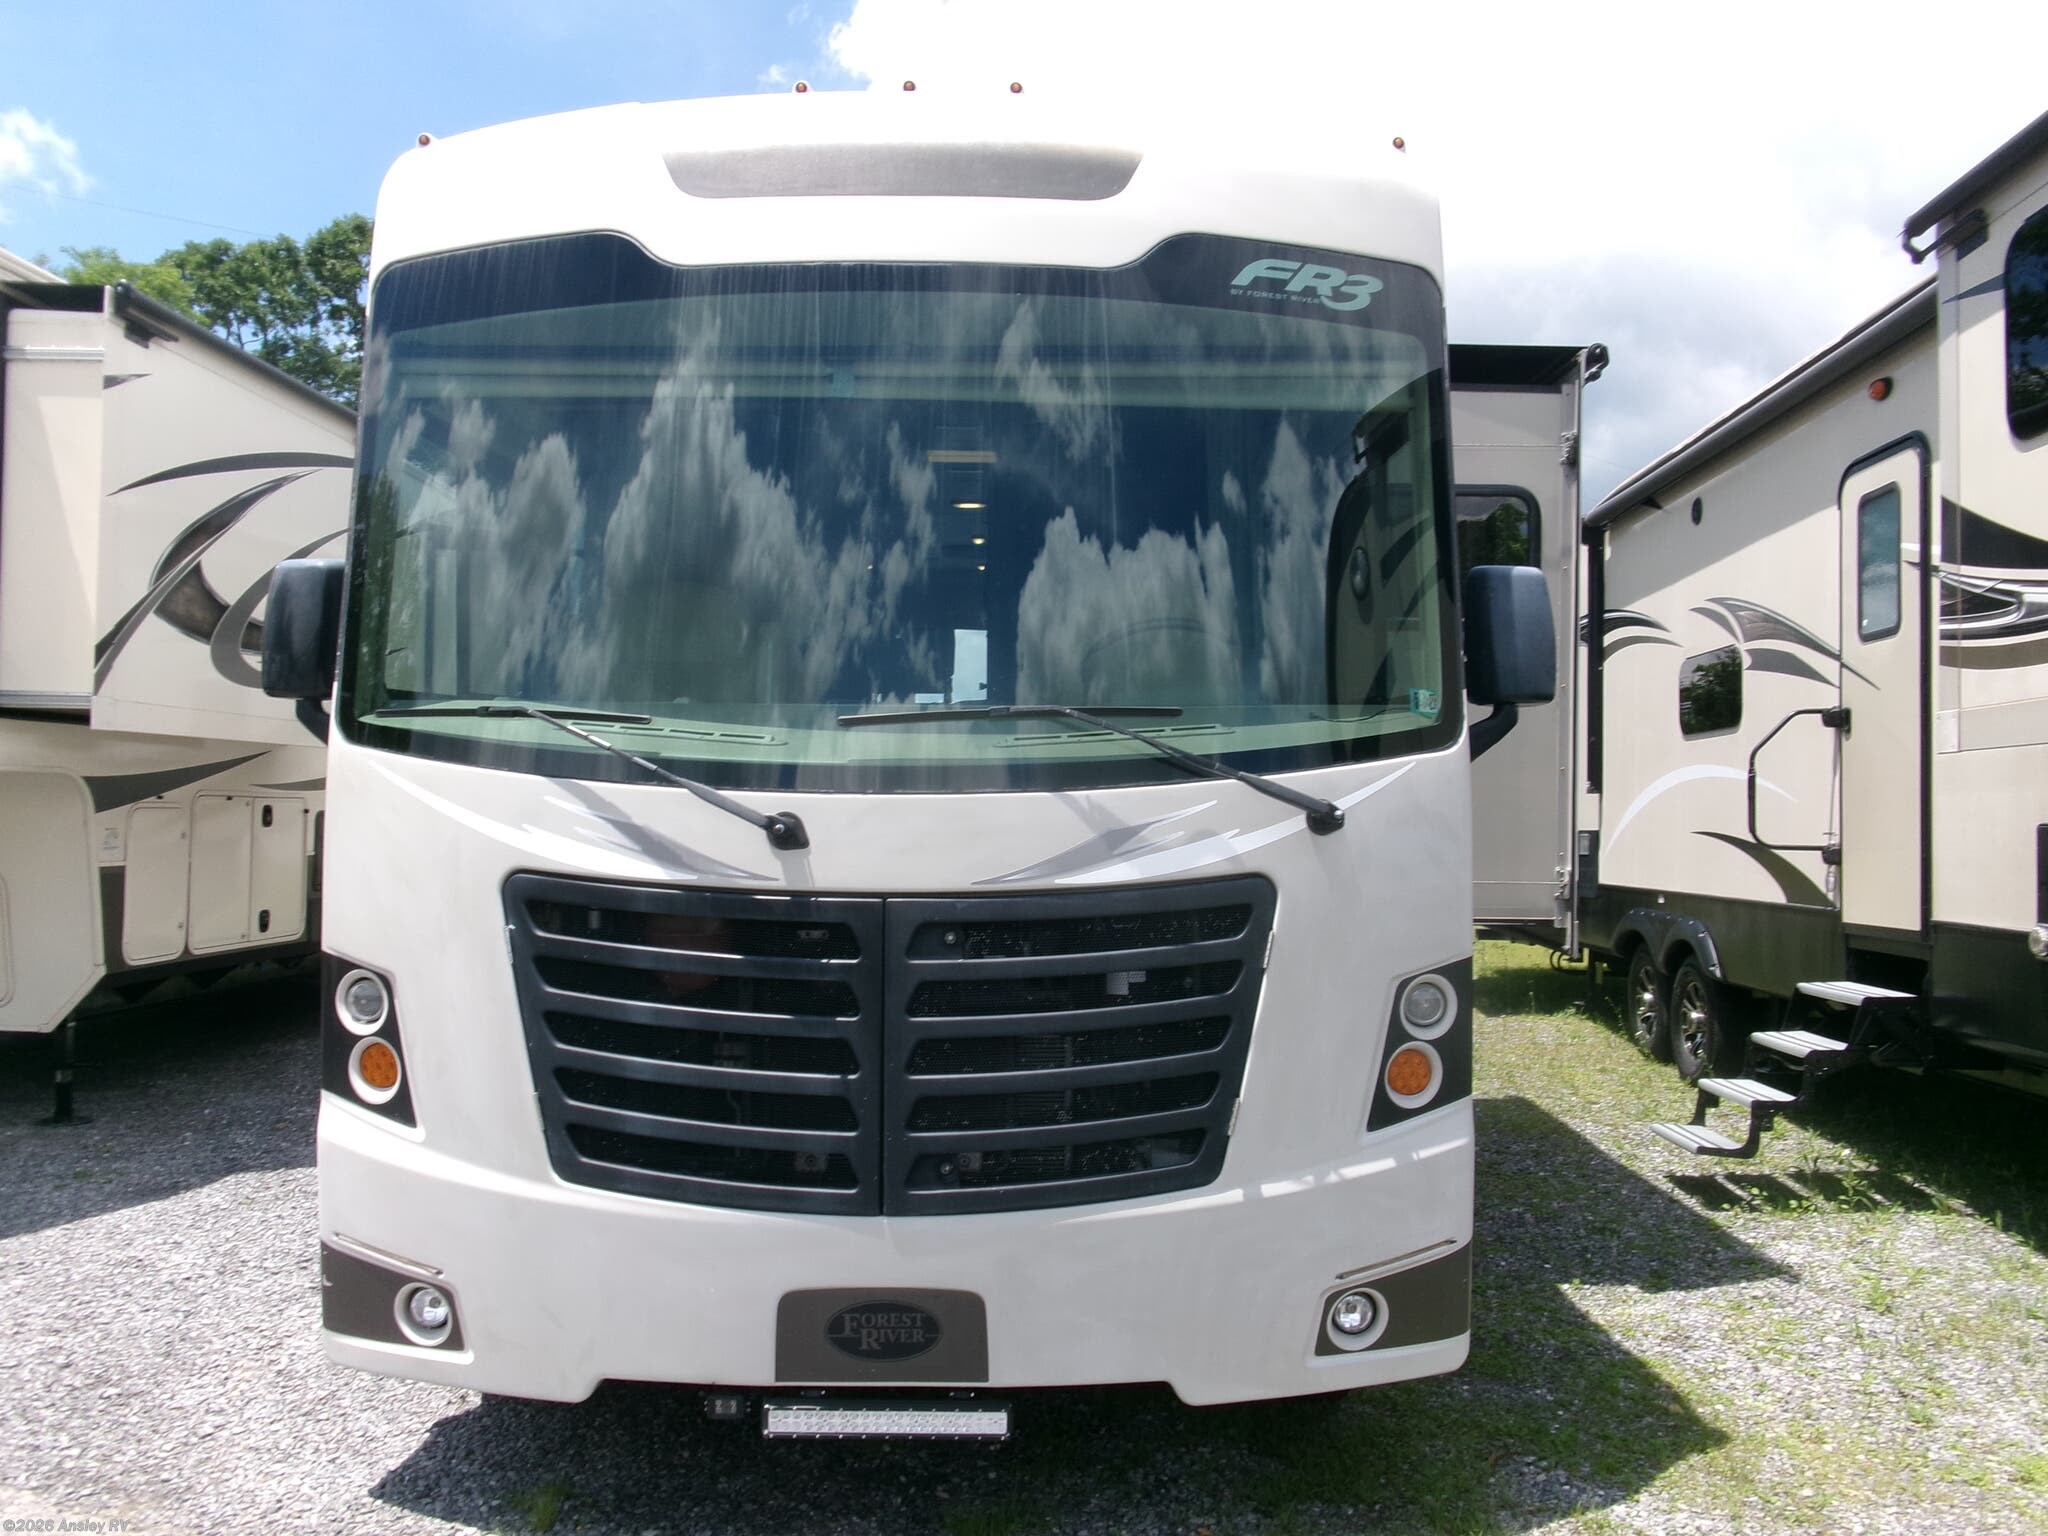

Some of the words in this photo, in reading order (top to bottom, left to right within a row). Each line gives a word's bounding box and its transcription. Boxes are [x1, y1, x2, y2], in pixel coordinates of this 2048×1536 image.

[1230, 258, 1384, 311] FR3
[1247, 290, 1288, 300] FOREST
[841, 1312, 928, 1337] FOREST
[859, 1328, 925, 1351] RIVER
